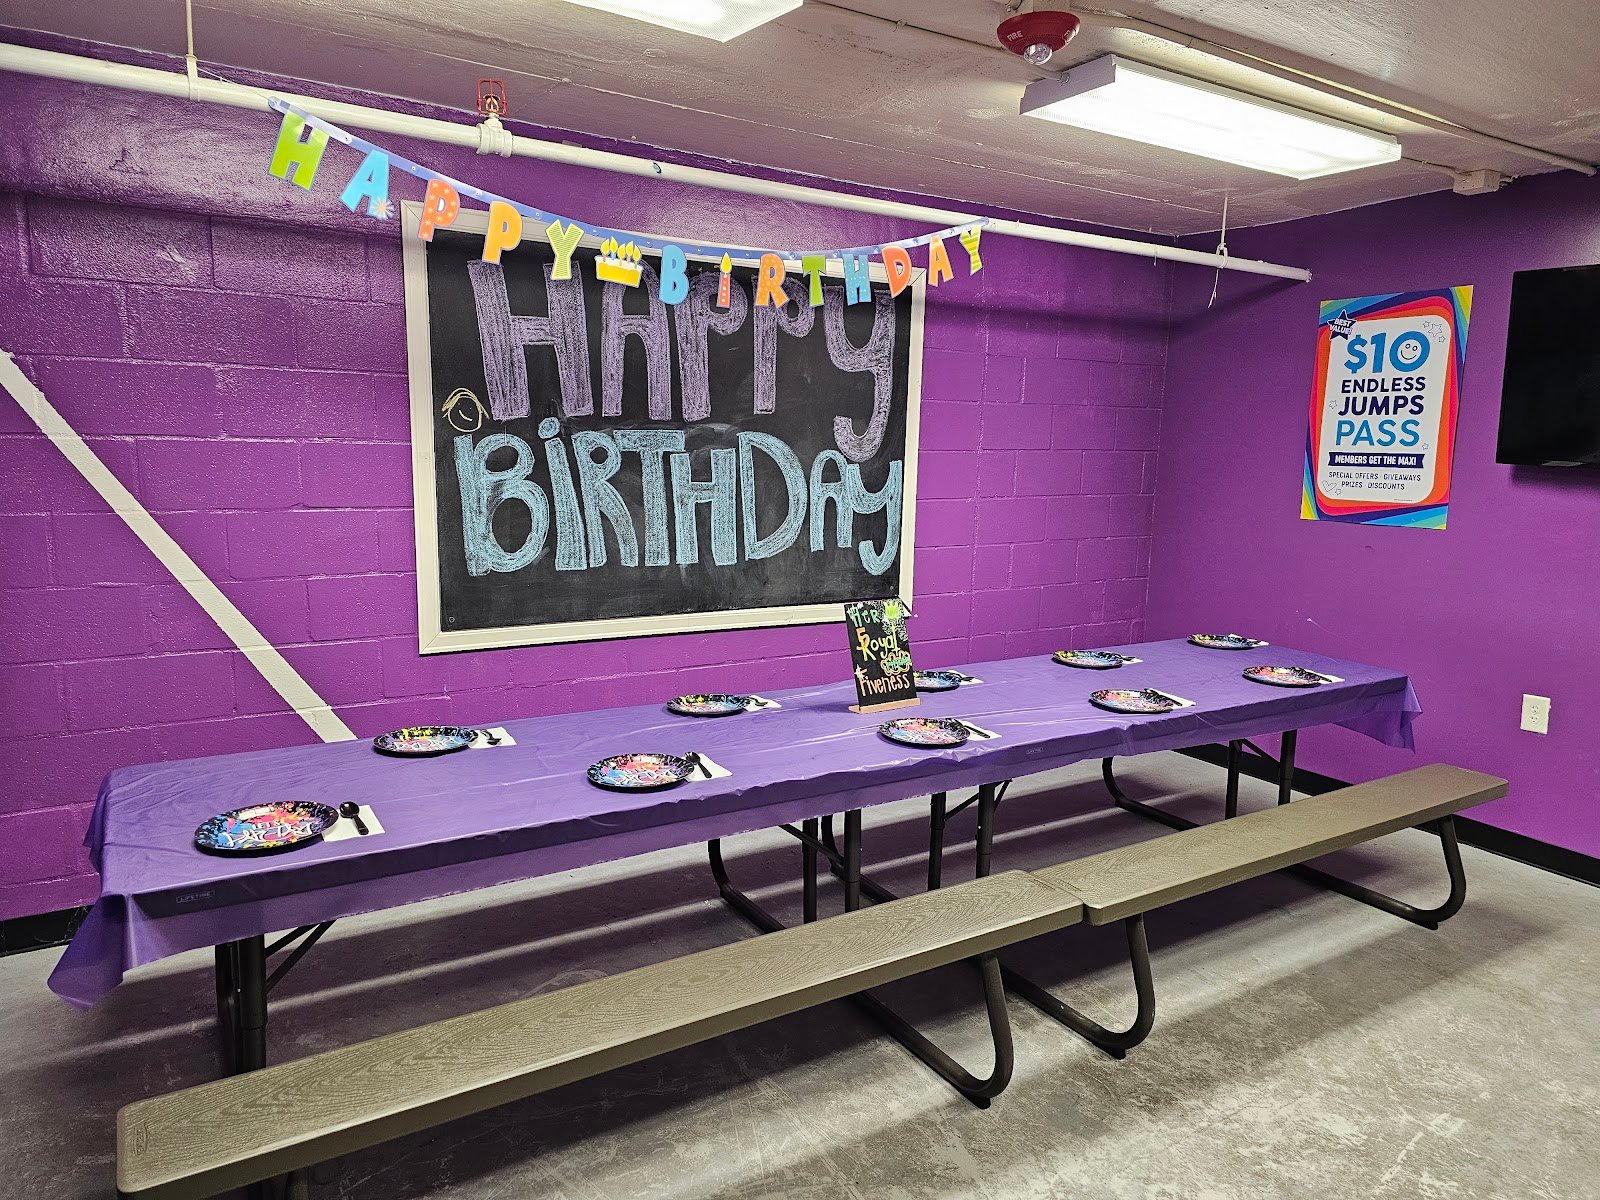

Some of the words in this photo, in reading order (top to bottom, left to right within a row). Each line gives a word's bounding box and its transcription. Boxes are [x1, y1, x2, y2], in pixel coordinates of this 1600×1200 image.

[1007, 30, 1023, 42] FIRE
[268, 106, 585, 281] HAPPY
[1334, 318, 1351, 327] BEST
[1344, 331, 1430, 374] $10
[1341, 377, 1426, 393] ENDLESS
[1338, 395, 1425, 416] JUMPS
[1335, 419, 1420, 447] PASS
[1334, 455, 1367, 464] MEMBERS
[1369, 455, 1382, 464] GET
[1383, 456, 1396, 465] THE
[1398, 456, 1417, 466] MAX!
[1355, 472, 1379, 480] OFFERS
[1383, 473, 1421, 481] GIVEAWAYS
[1367, 482, 1405, 490] DISCOUNTS
